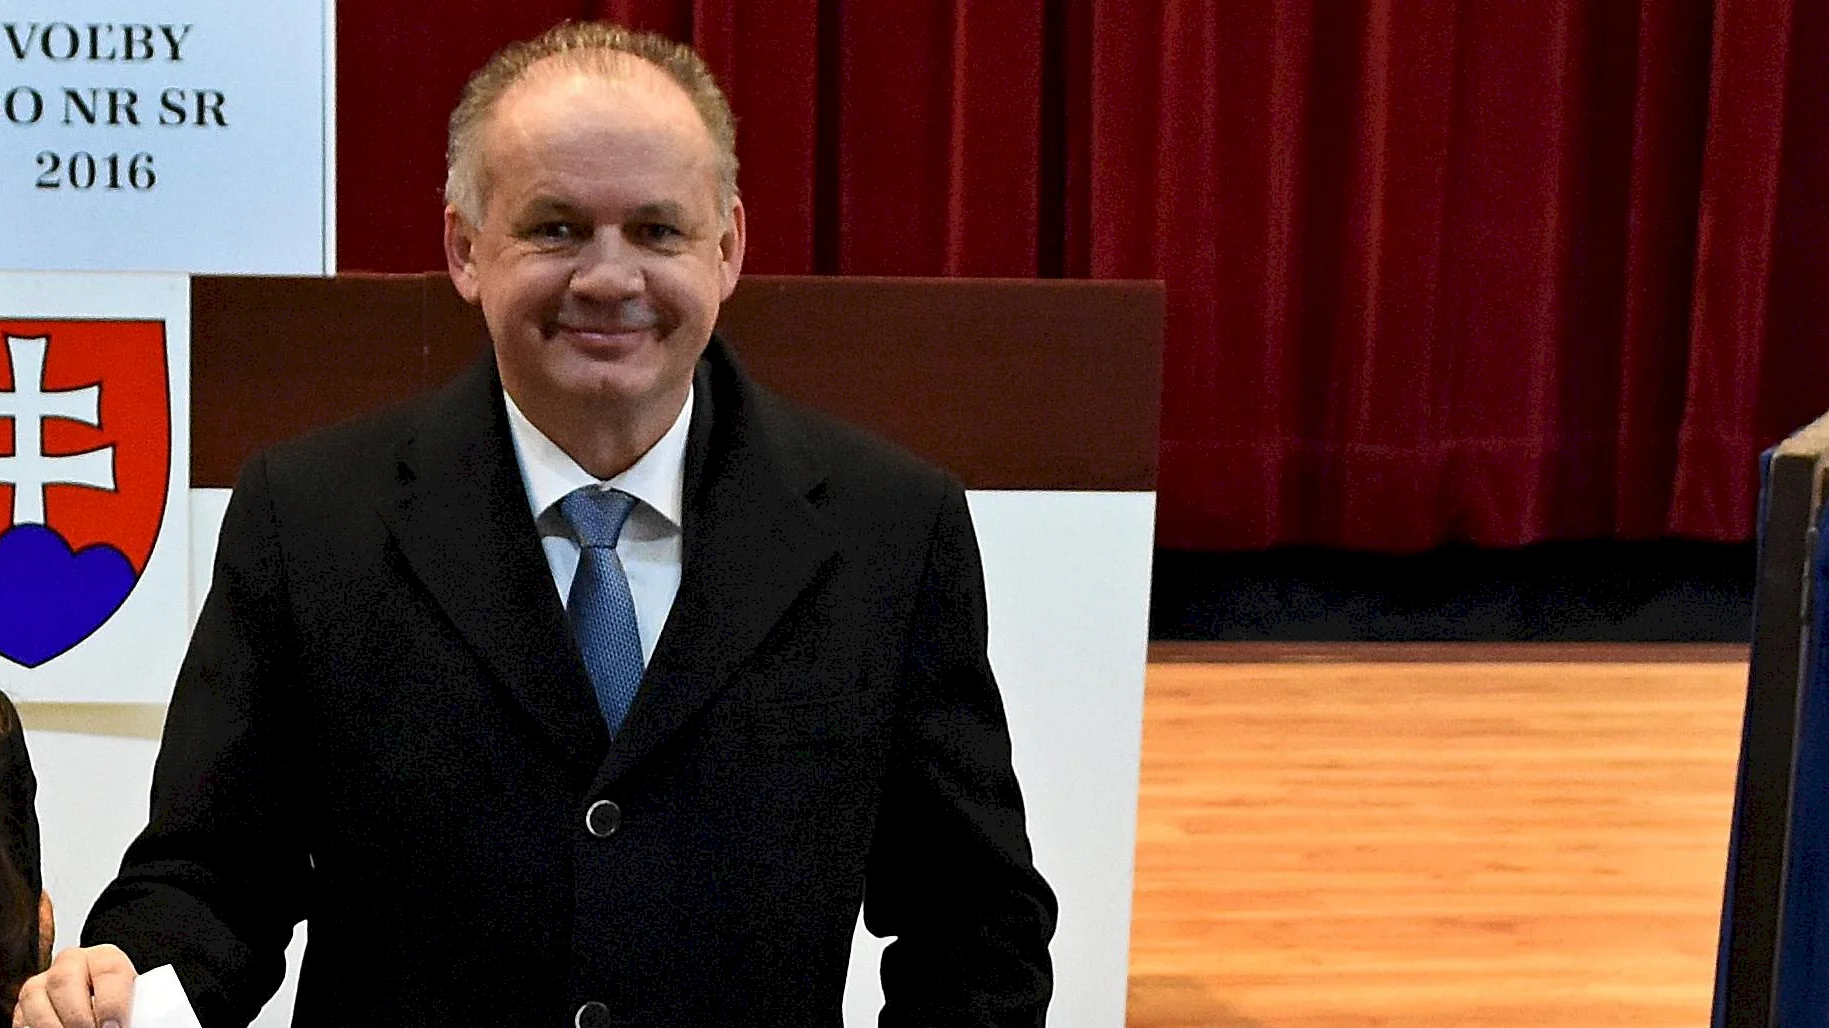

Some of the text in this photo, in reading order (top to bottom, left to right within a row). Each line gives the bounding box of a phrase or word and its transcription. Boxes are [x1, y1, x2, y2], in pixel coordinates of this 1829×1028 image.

[2, 22, 192, 61] VOĽBY
[61, 87, 142, 126] NR
[158, 87, 229, 127] SR
[34, 150, 157, 190] 2016
